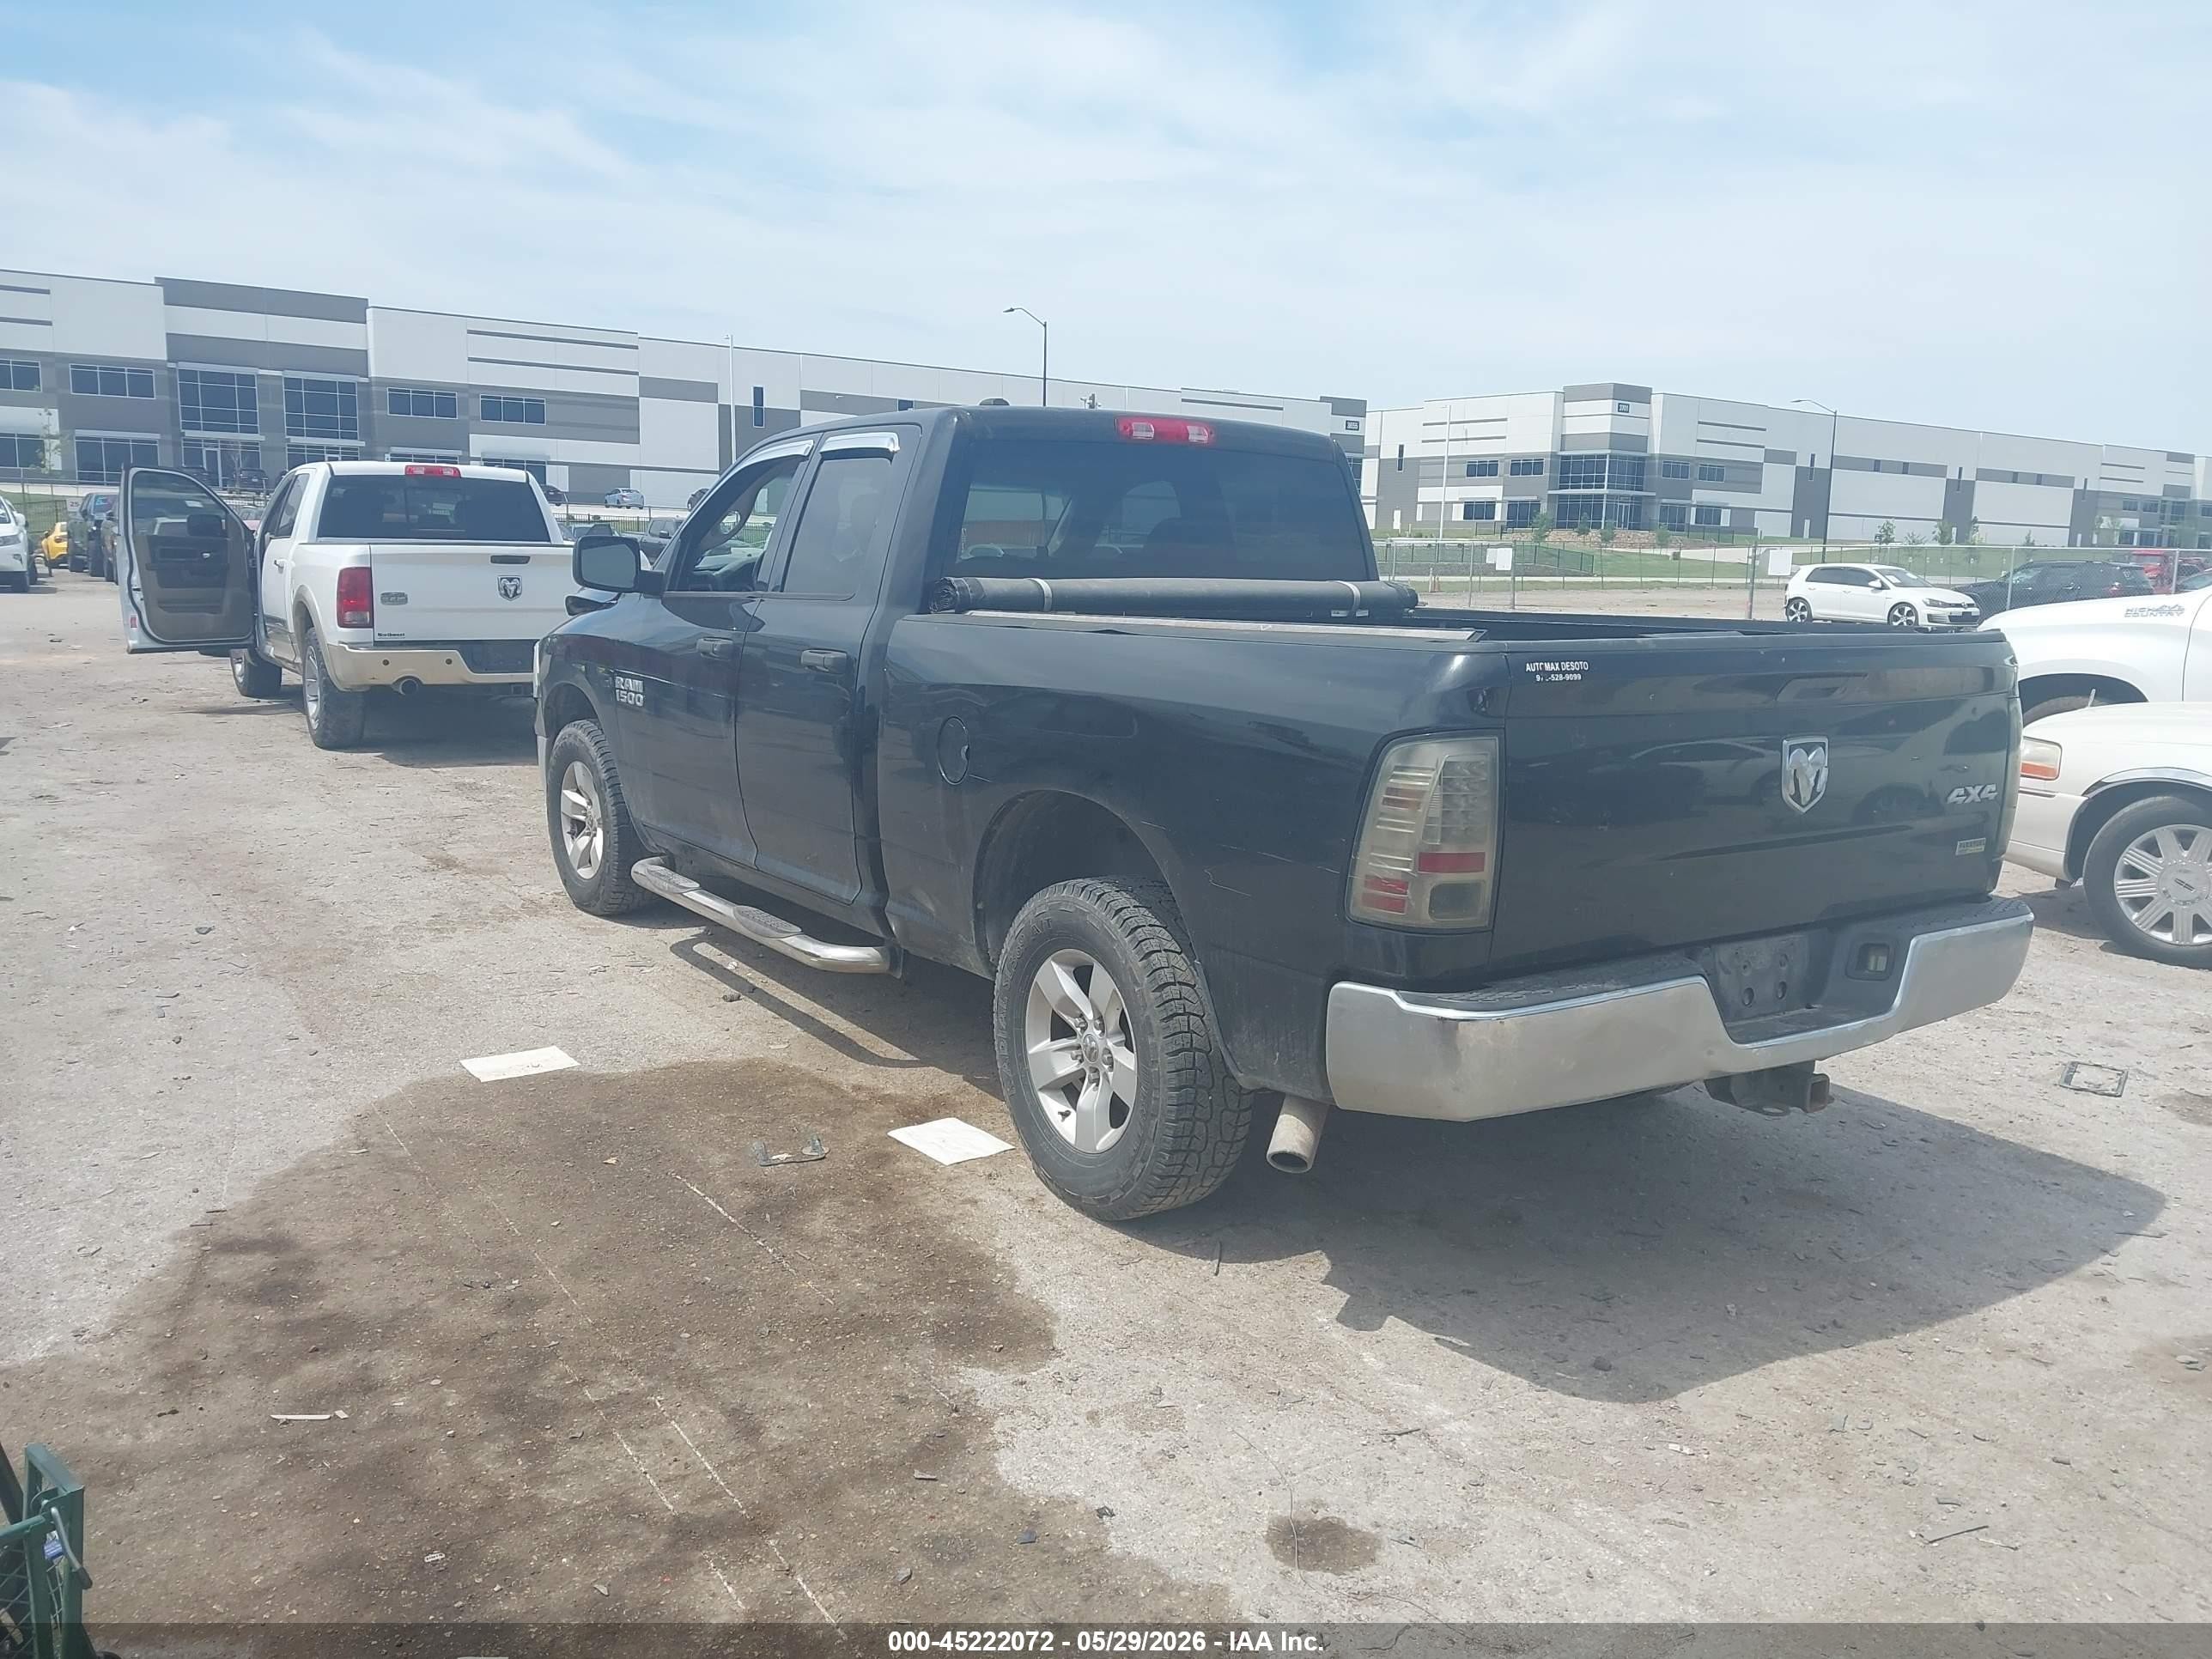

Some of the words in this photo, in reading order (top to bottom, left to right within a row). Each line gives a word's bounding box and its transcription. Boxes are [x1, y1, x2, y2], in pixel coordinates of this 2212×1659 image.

[1560, 661, 1589, 671] DESOTO
[1535, 673, 1582, 682] 9-528-9099
[615, 676, 644, 693] RAM
[615, 689, 644, 707] 1500
